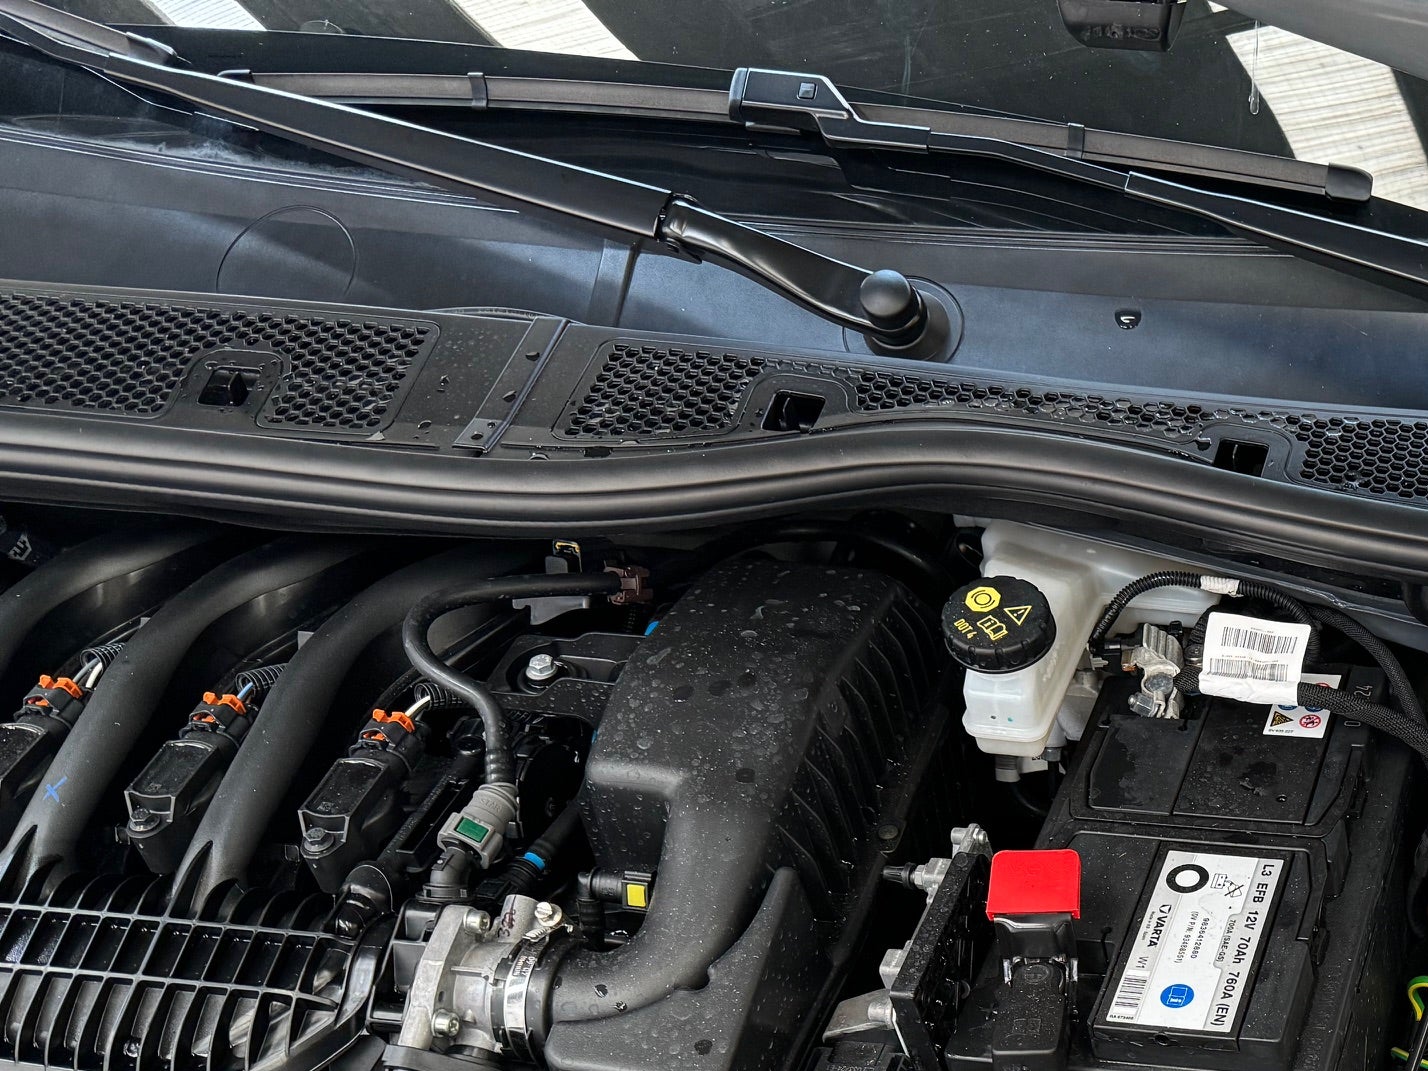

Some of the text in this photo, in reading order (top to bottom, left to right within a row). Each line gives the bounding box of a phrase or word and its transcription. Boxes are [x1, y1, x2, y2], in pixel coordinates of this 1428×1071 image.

[954, 618, 974, 633] DOT
[1147, 916, 1168, 948] VARTA
[1210, 863, 1273, 1027] L3 EFB 12V 70Ah 760A (EN)
[1136, 956, 1149, 969] W1
